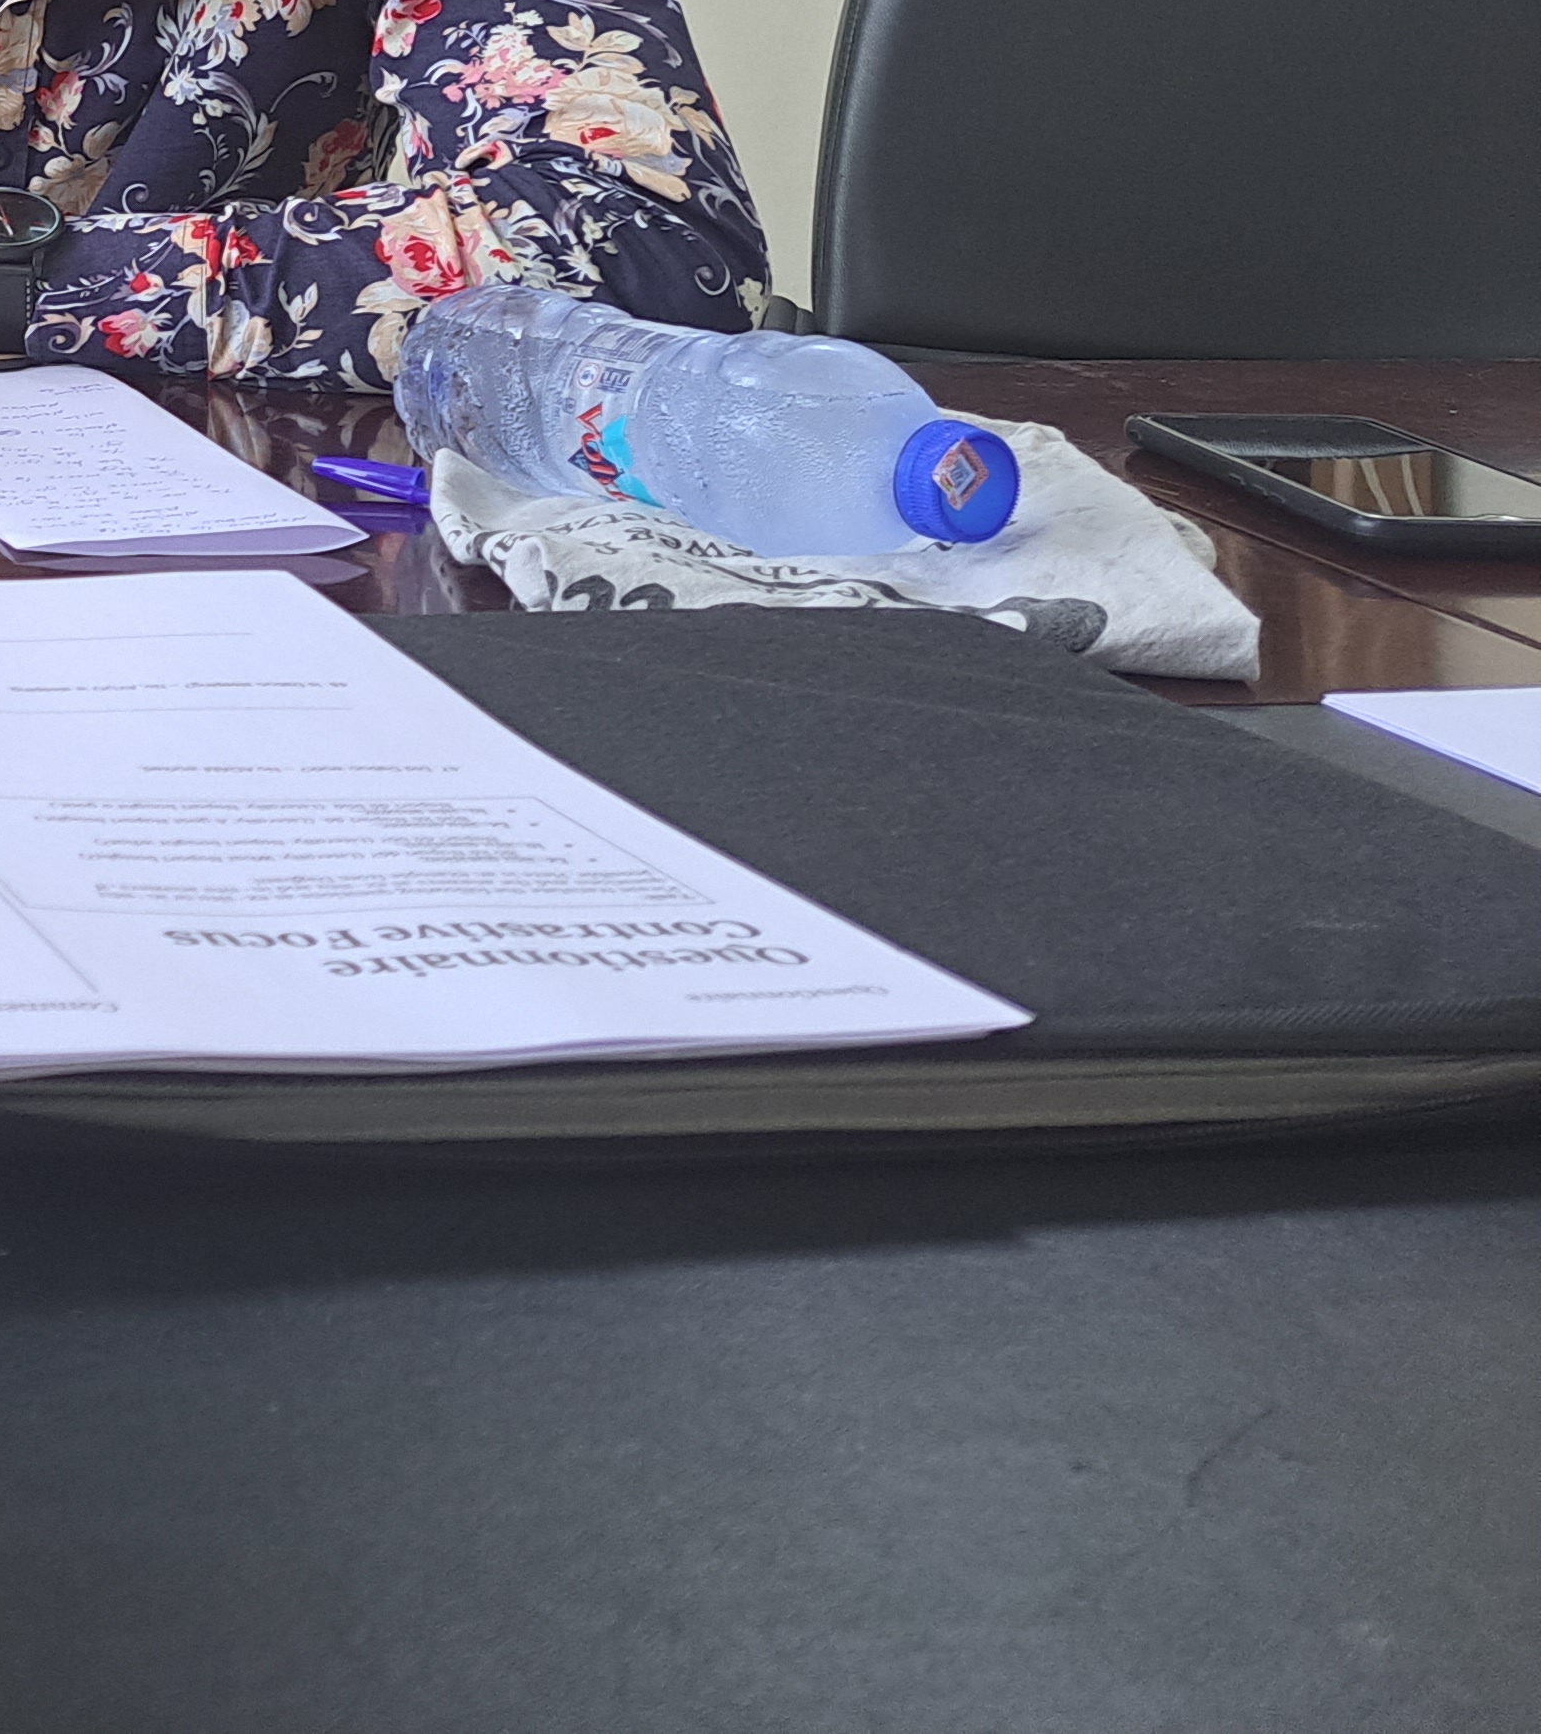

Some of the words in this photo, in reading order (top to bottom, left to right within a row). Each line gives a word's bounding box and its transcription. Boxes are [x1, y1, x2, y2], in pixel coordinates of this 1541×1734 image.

[162, 928, 370, 951] Focus
[373, 919, 763, 944] Contrastive
[323, 944, 810, 978] Questionnaire
[684, 985, 889, 1003] Questionnaire
